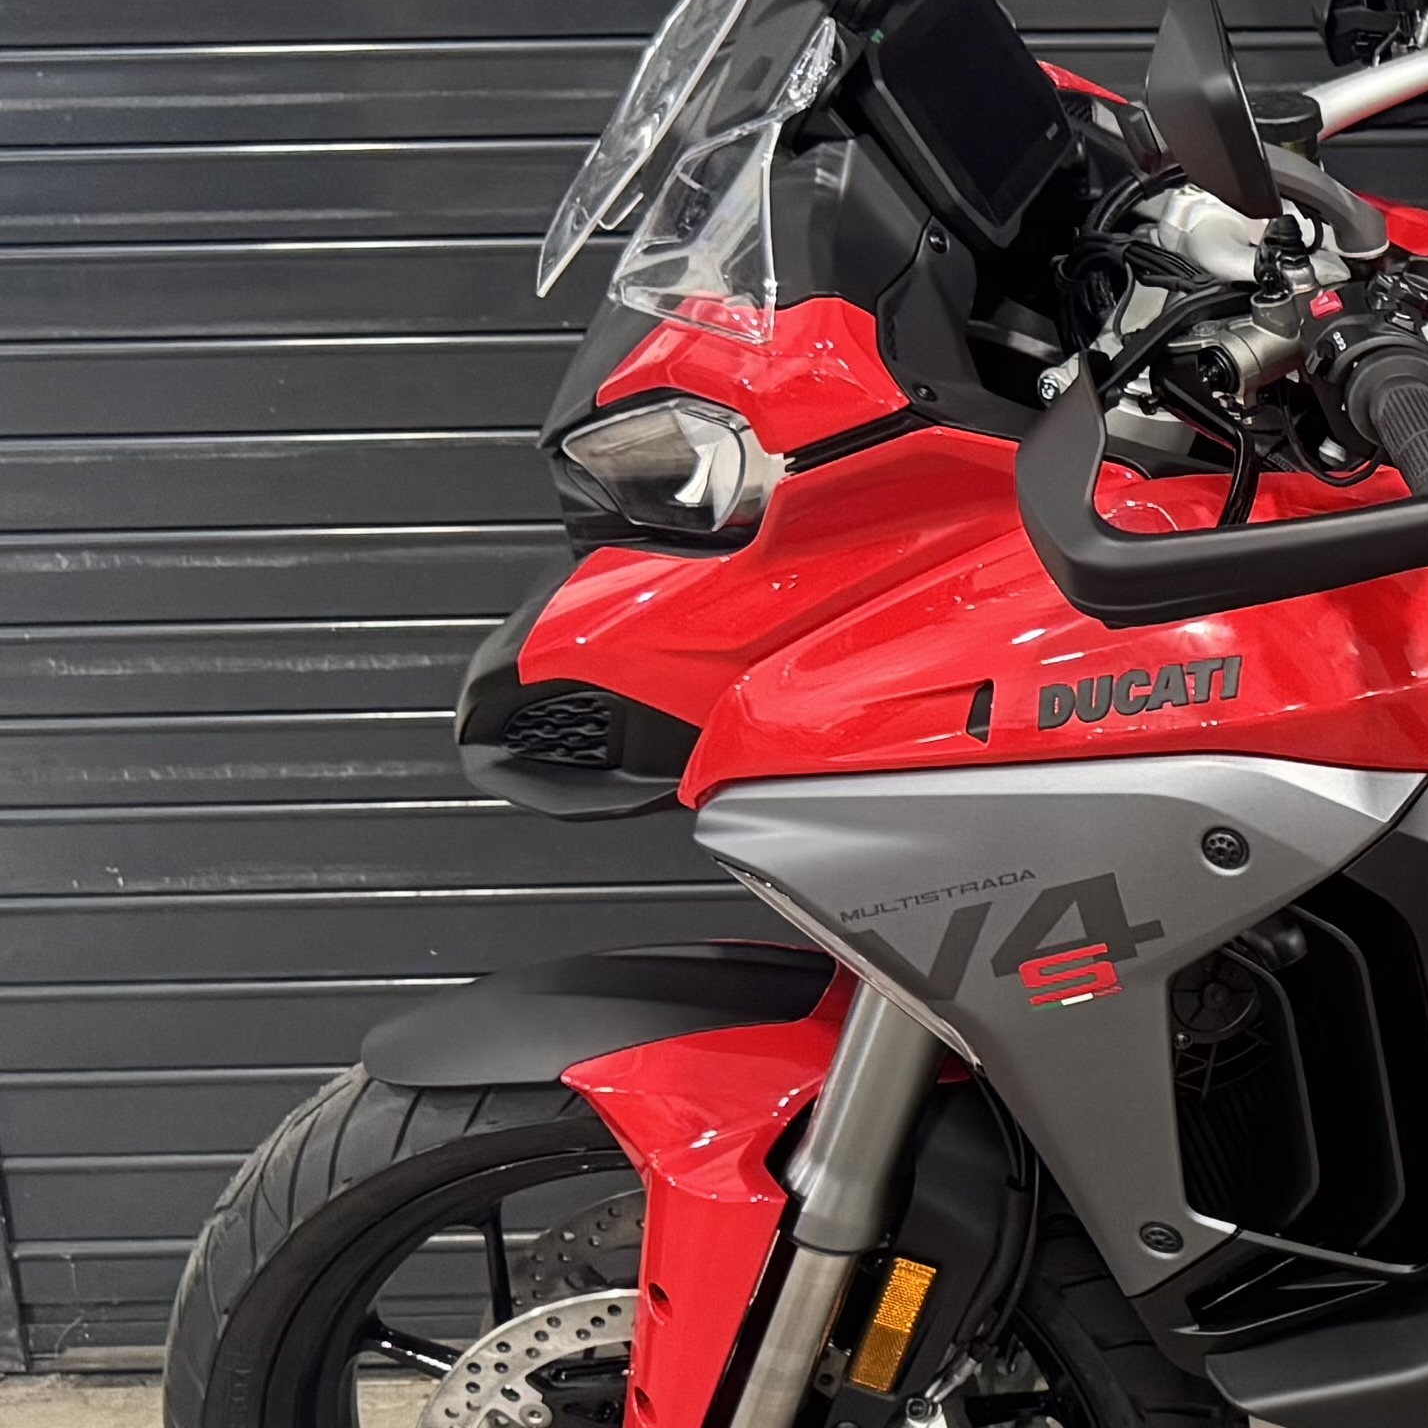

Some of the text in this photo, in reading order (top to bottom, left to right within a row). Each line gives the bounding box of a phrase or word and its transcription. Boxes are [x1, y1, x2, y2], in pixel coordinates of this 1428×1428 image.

[1038, 655, 1242, 731] DUCATI
[838, 869, 1036, 923] MULTISTRADA
[846, 872, 1165, 1005] V4 S
